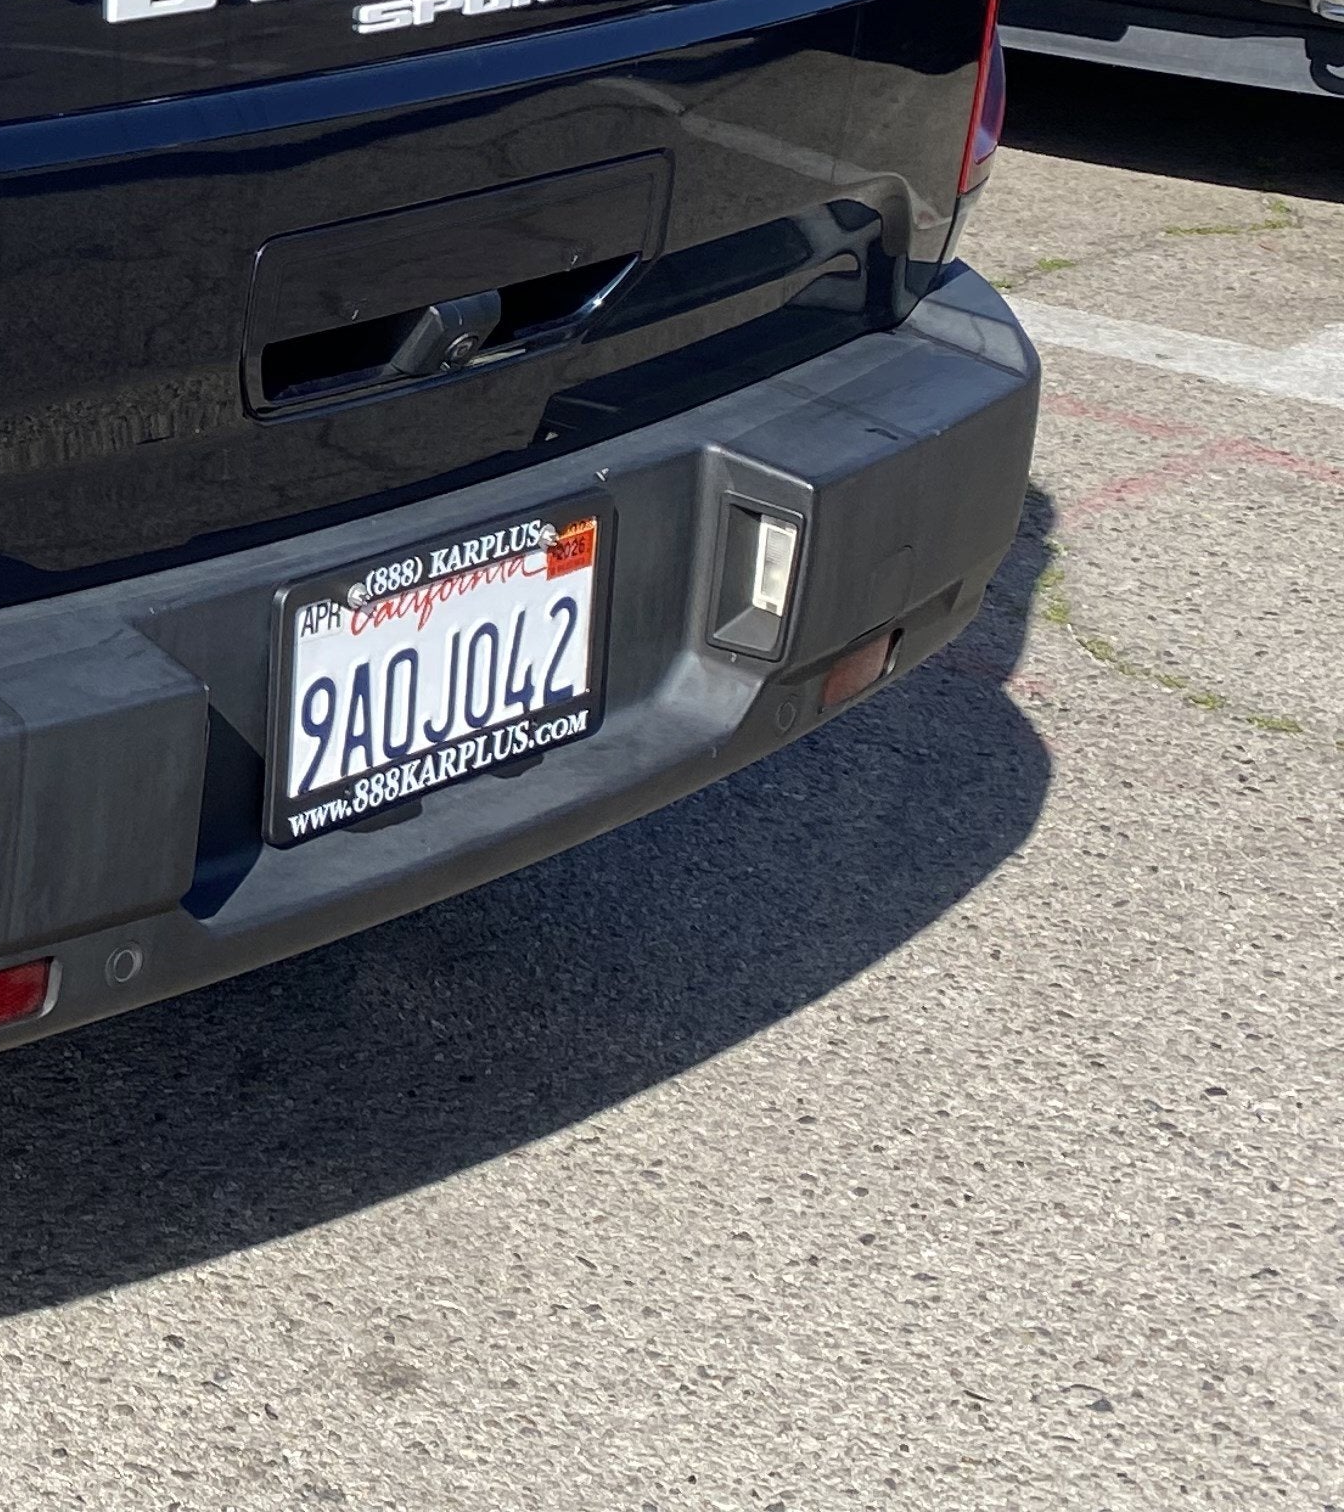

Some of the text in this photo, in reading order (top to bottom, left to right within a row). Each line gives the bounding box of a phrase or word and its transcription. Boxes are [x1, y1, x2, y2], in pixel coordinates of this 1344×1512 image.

[365, 519, 542, 597] (888) KARPLUS
[300, 598, 343, 639] APR
